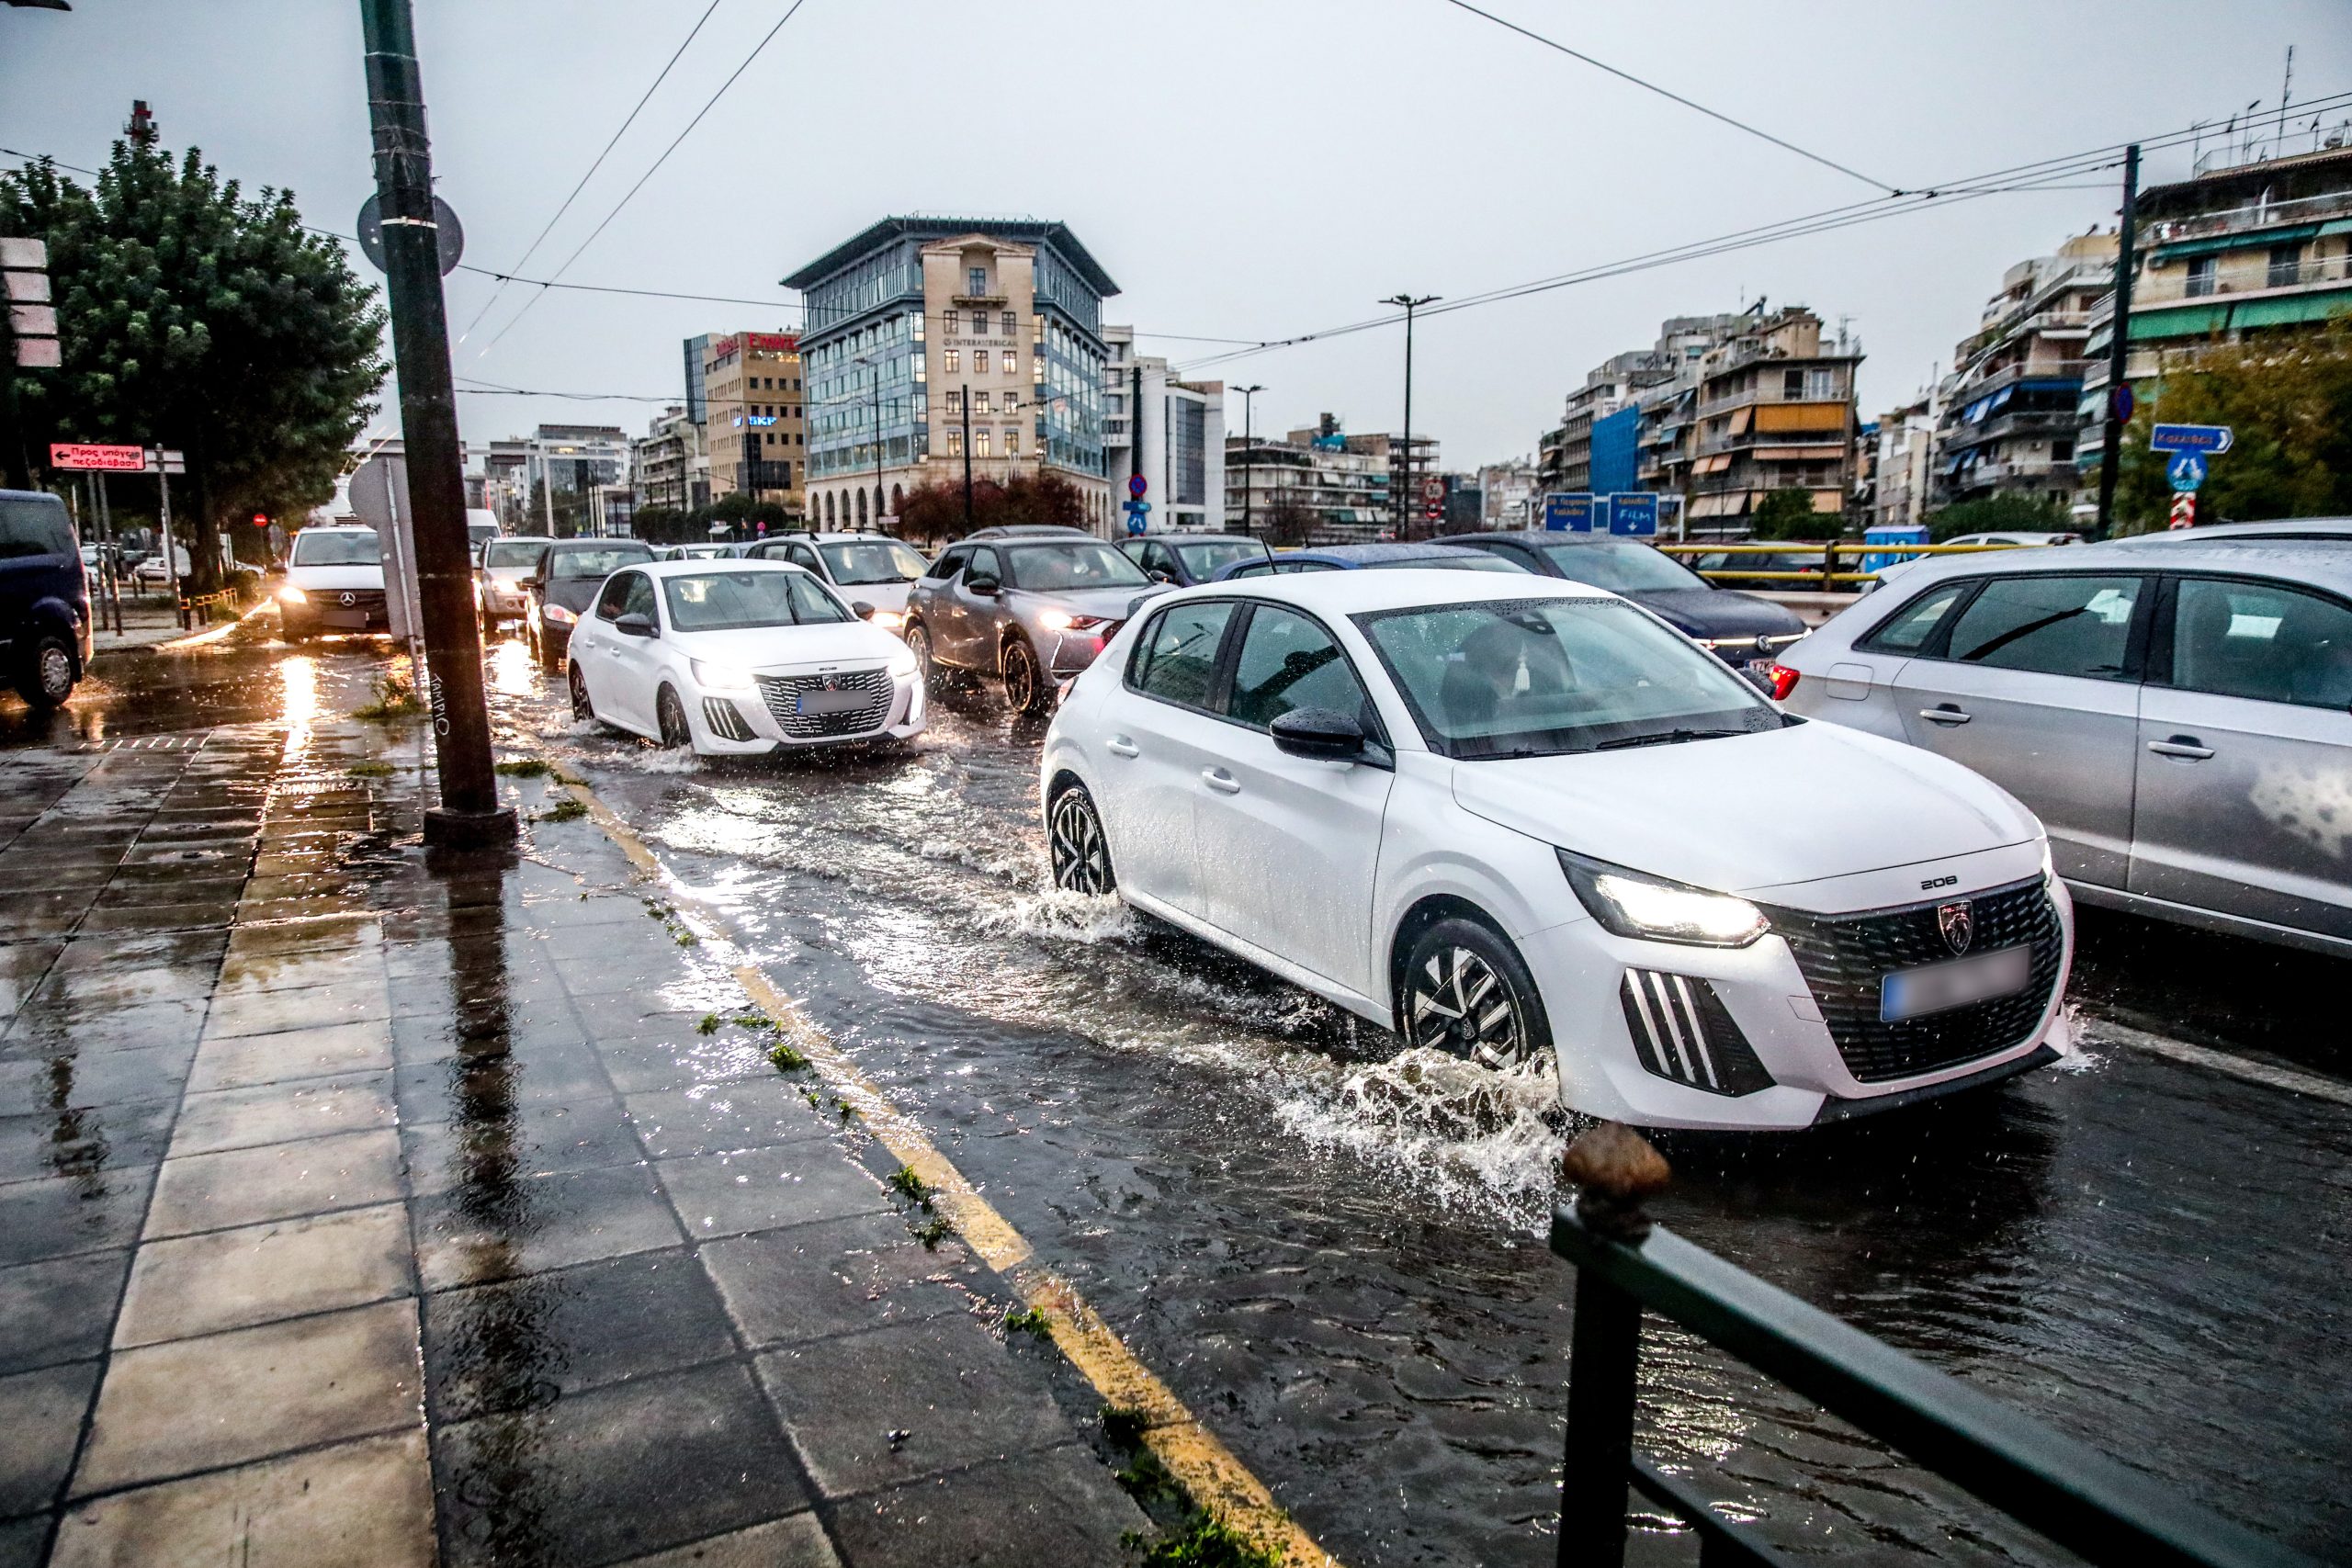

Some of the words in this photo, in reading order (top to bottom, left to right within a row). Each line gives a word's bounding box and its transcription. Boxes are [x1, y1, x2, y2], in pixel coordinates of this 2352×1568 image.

[72, 447, 98, 457] Προς
[1620, 509, 1652, 522] FILM
[1921, 875, 1958, 890] 208
